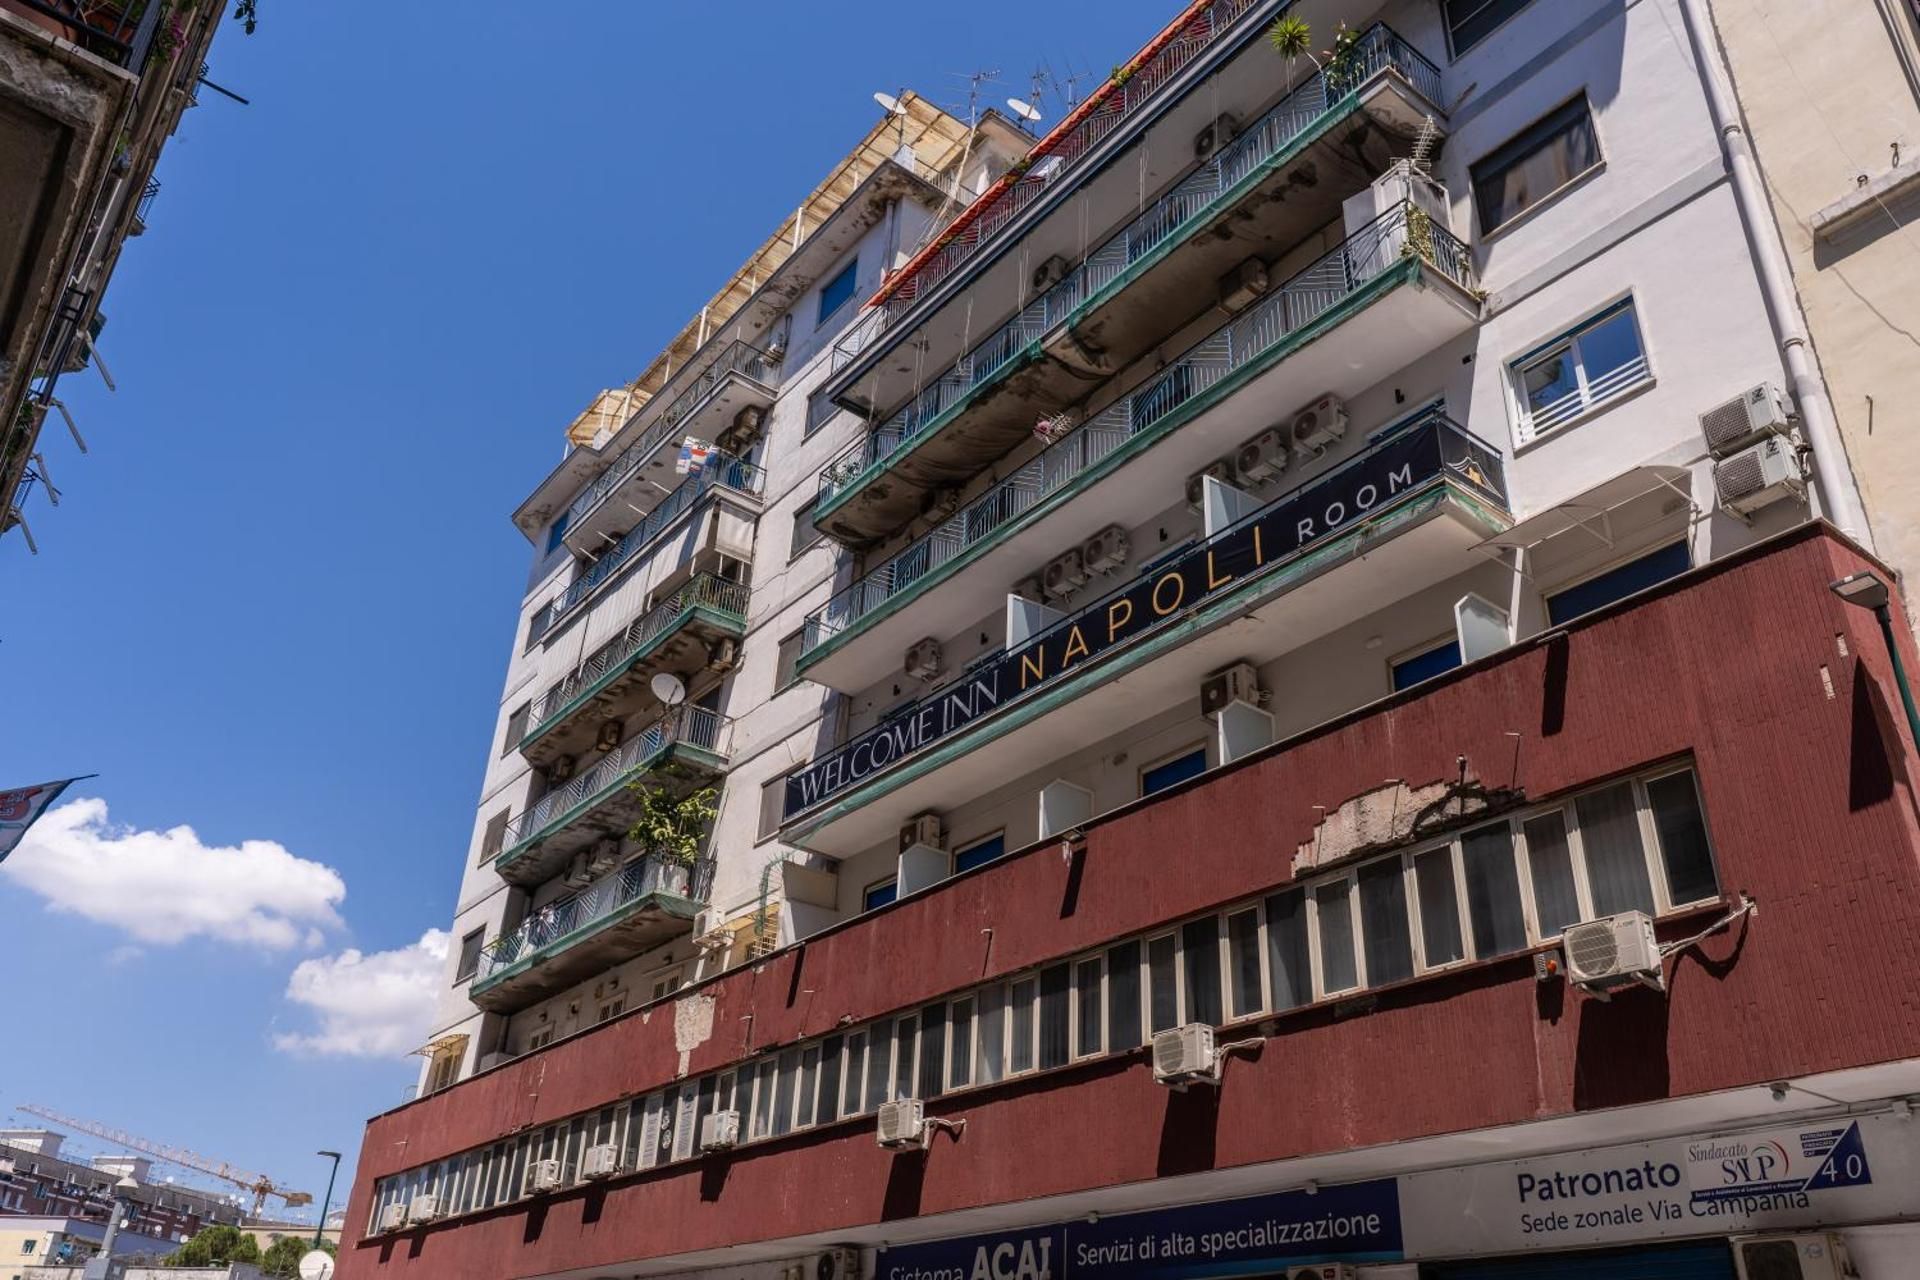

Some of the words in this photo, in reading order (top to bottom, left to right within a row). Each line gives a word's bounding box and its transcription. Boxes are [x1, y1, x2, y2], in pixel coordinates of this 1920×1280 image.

[801, 707, 934, 805] WELCOME
[942, 669, 999, 734] INN
[1021, 525, 1263, 689] NAPOLI
[1297, 463, 1412, 543] ROOM
[1688, 1142, 1748, 1162] Sindacato
[1517, 1160, 1681, 1203] Patronato
[1521, 1211, 1569, 1233] Sede
[1574, 1204, 1643, 1228] zonale
[1648, 1200, 1682, 1221] Via
[1689, 1191, 1811, 1218] Campania
[970, 1237, 1052, 1280] ACAI
[1077, 1238, 1134, 1265] Servizi
[1139, 1236, 1155, 1259] di
[1161, 1231, 1196, 1257] alta
[1200, 1212, 1381, 1258] specializzazione
